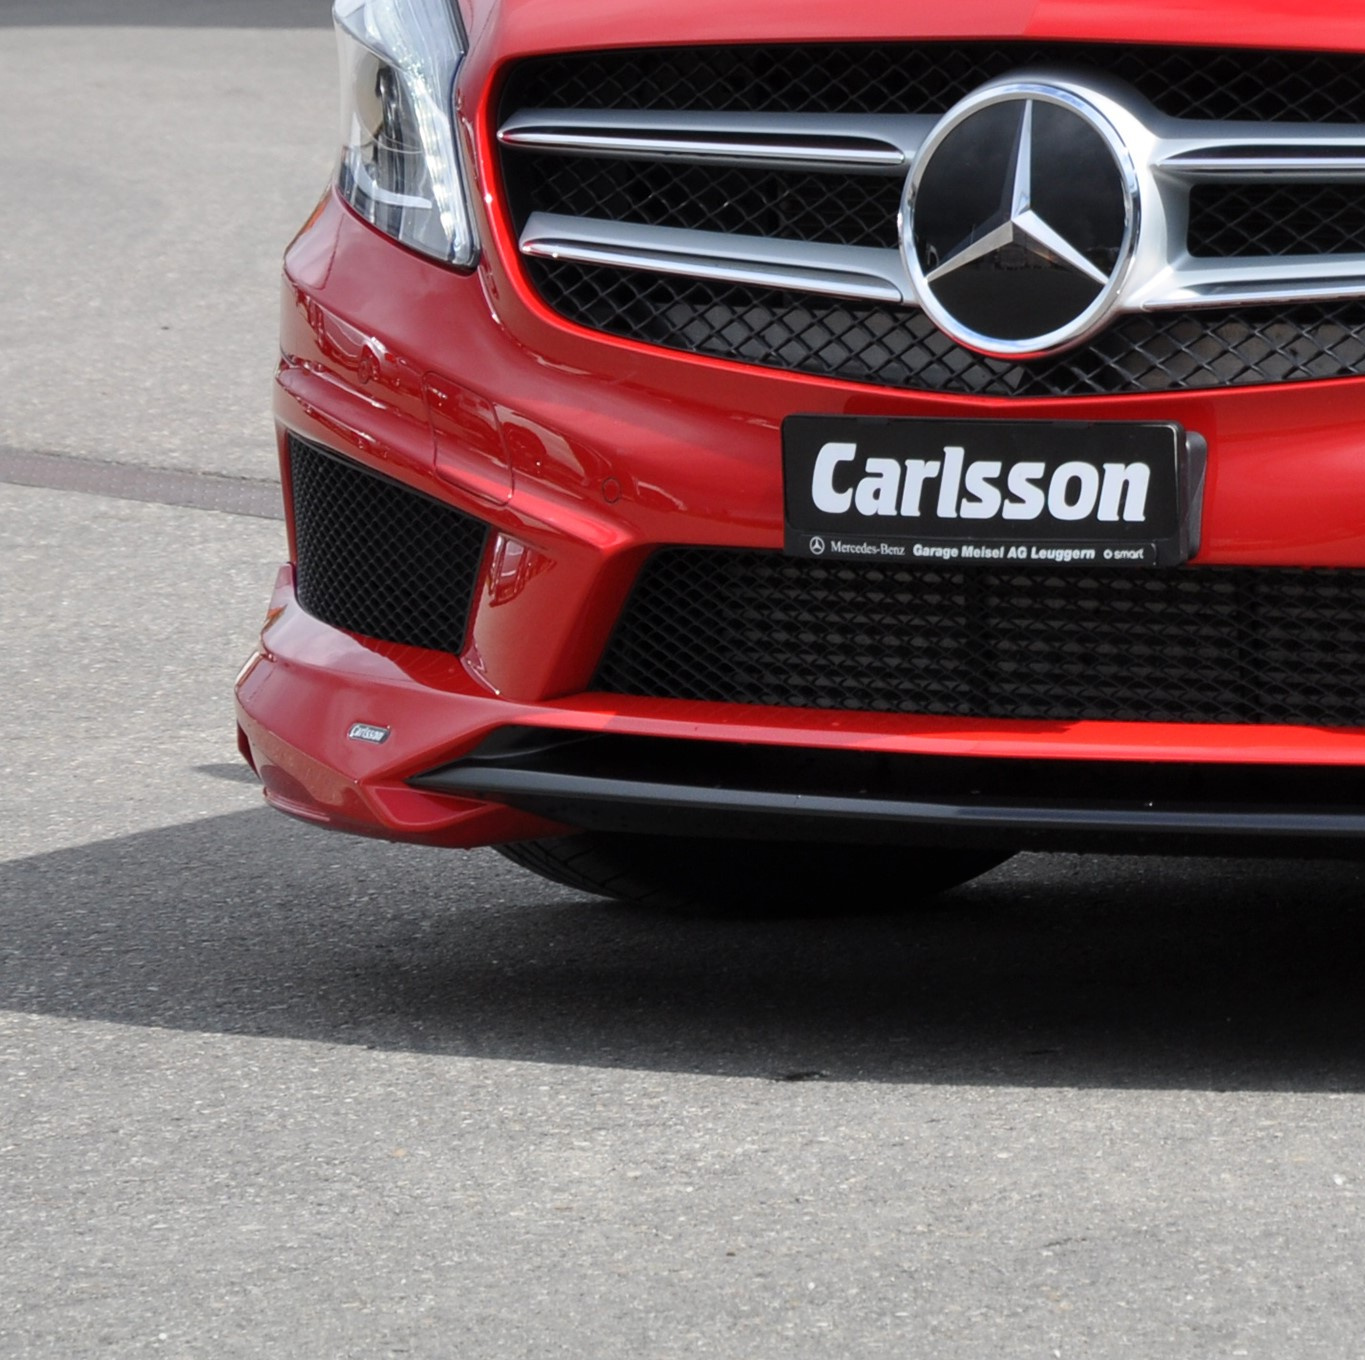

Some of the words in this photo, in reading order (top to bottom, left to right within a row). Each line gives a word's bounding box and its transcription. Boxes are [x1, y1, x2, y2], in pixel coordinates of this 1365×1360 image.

[811, 441, 1151, 522] Carlsson
[830, 540, 906, 556] Mercedes-Benz
[912, 543, 958, 560] Garage
[961, 545, 1004, 559] Meisel
[1007, 546, 1027, 559] AG
[1030, 546, 1096, 562] Leuggern
[1113, 547, 1144, 560] smart
